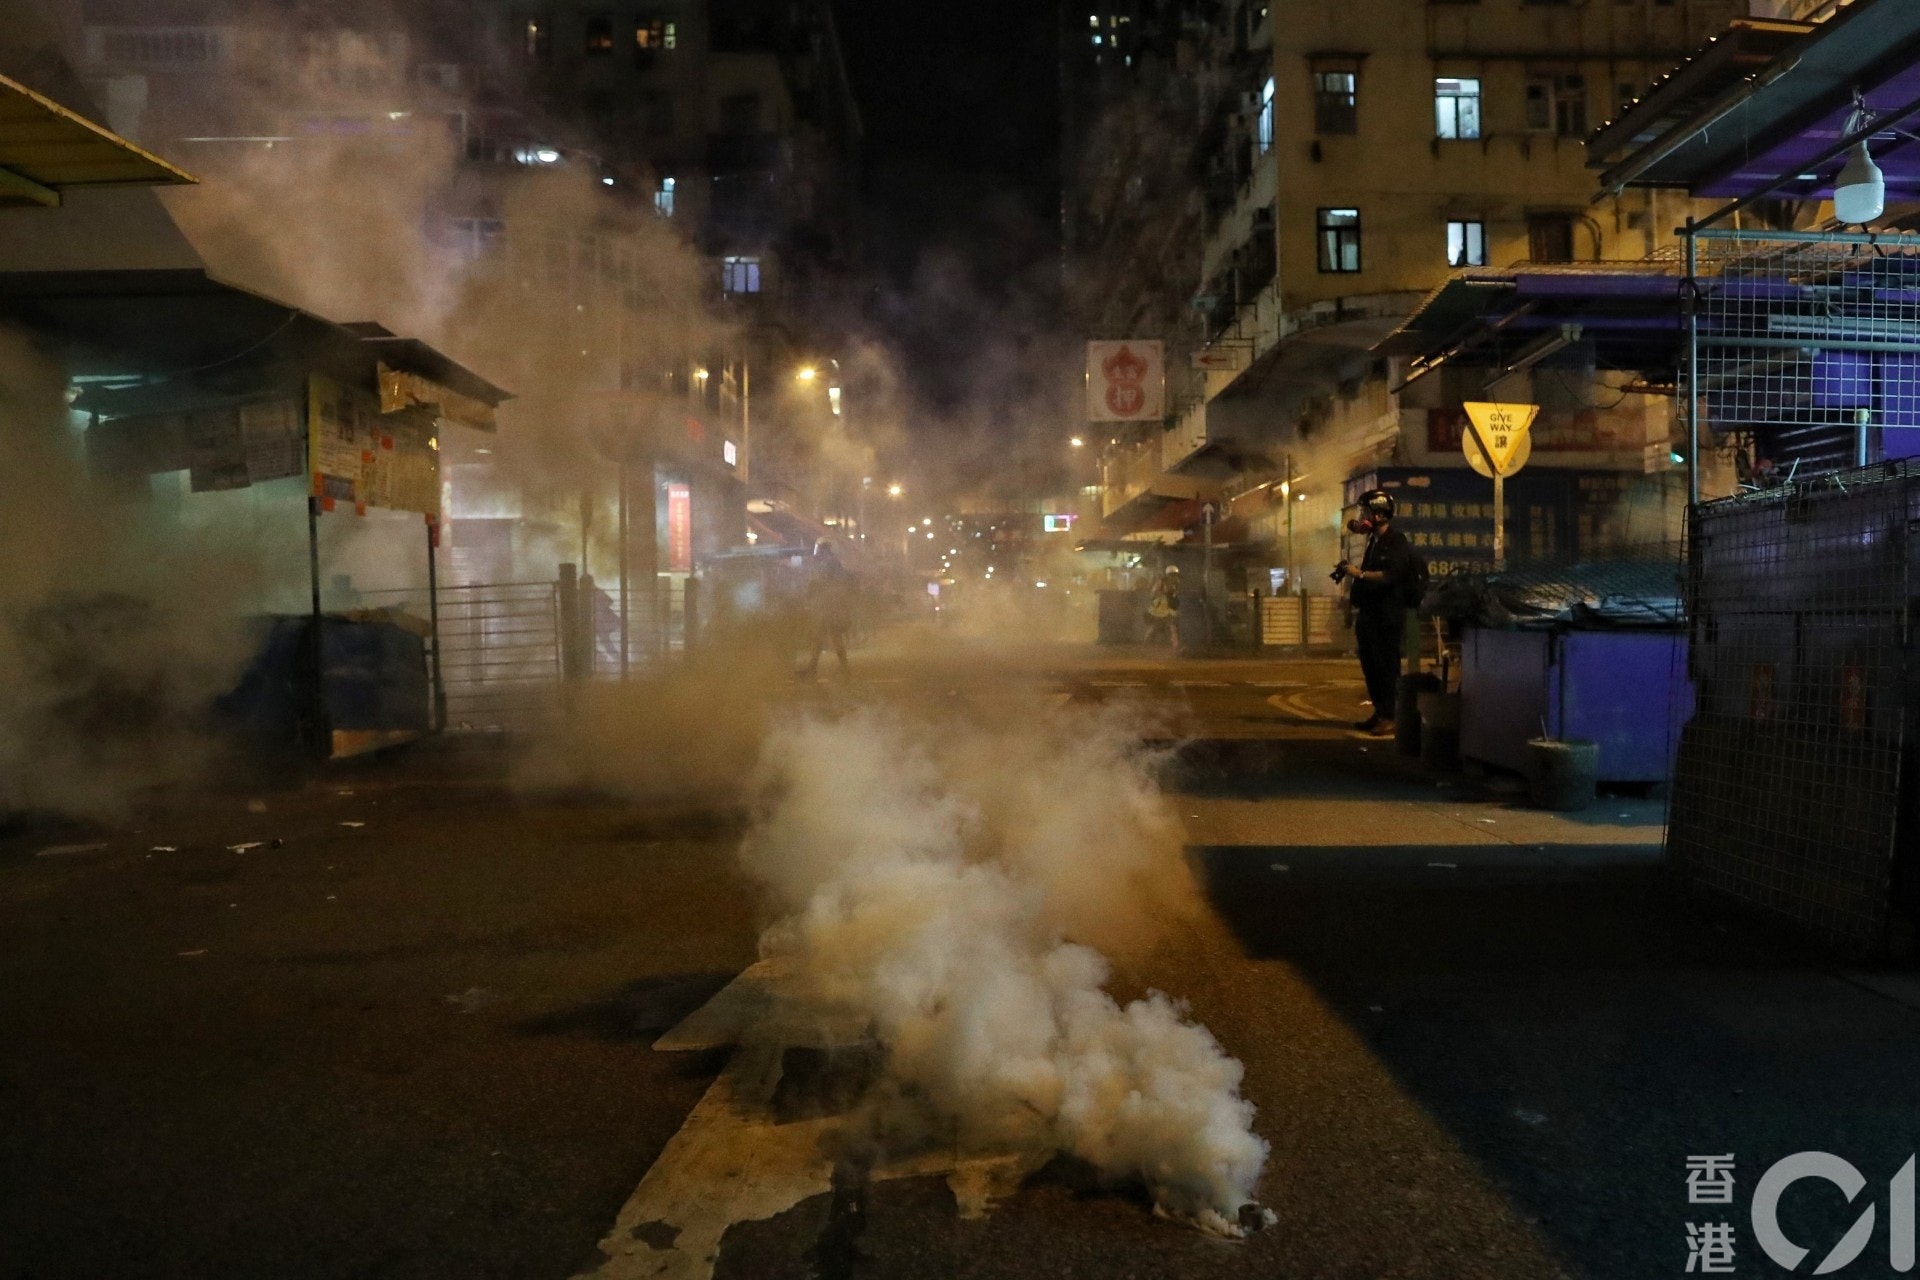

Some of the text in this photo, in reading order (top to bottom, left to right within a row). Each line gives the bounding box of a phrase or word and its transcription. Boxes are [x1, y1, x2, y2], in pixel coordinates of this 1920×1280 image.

[1490, 413, 1513, 422] GIVE
[1489, 423, 1513, 432] WAY
[1494, 434, 1508, 449] 讓
